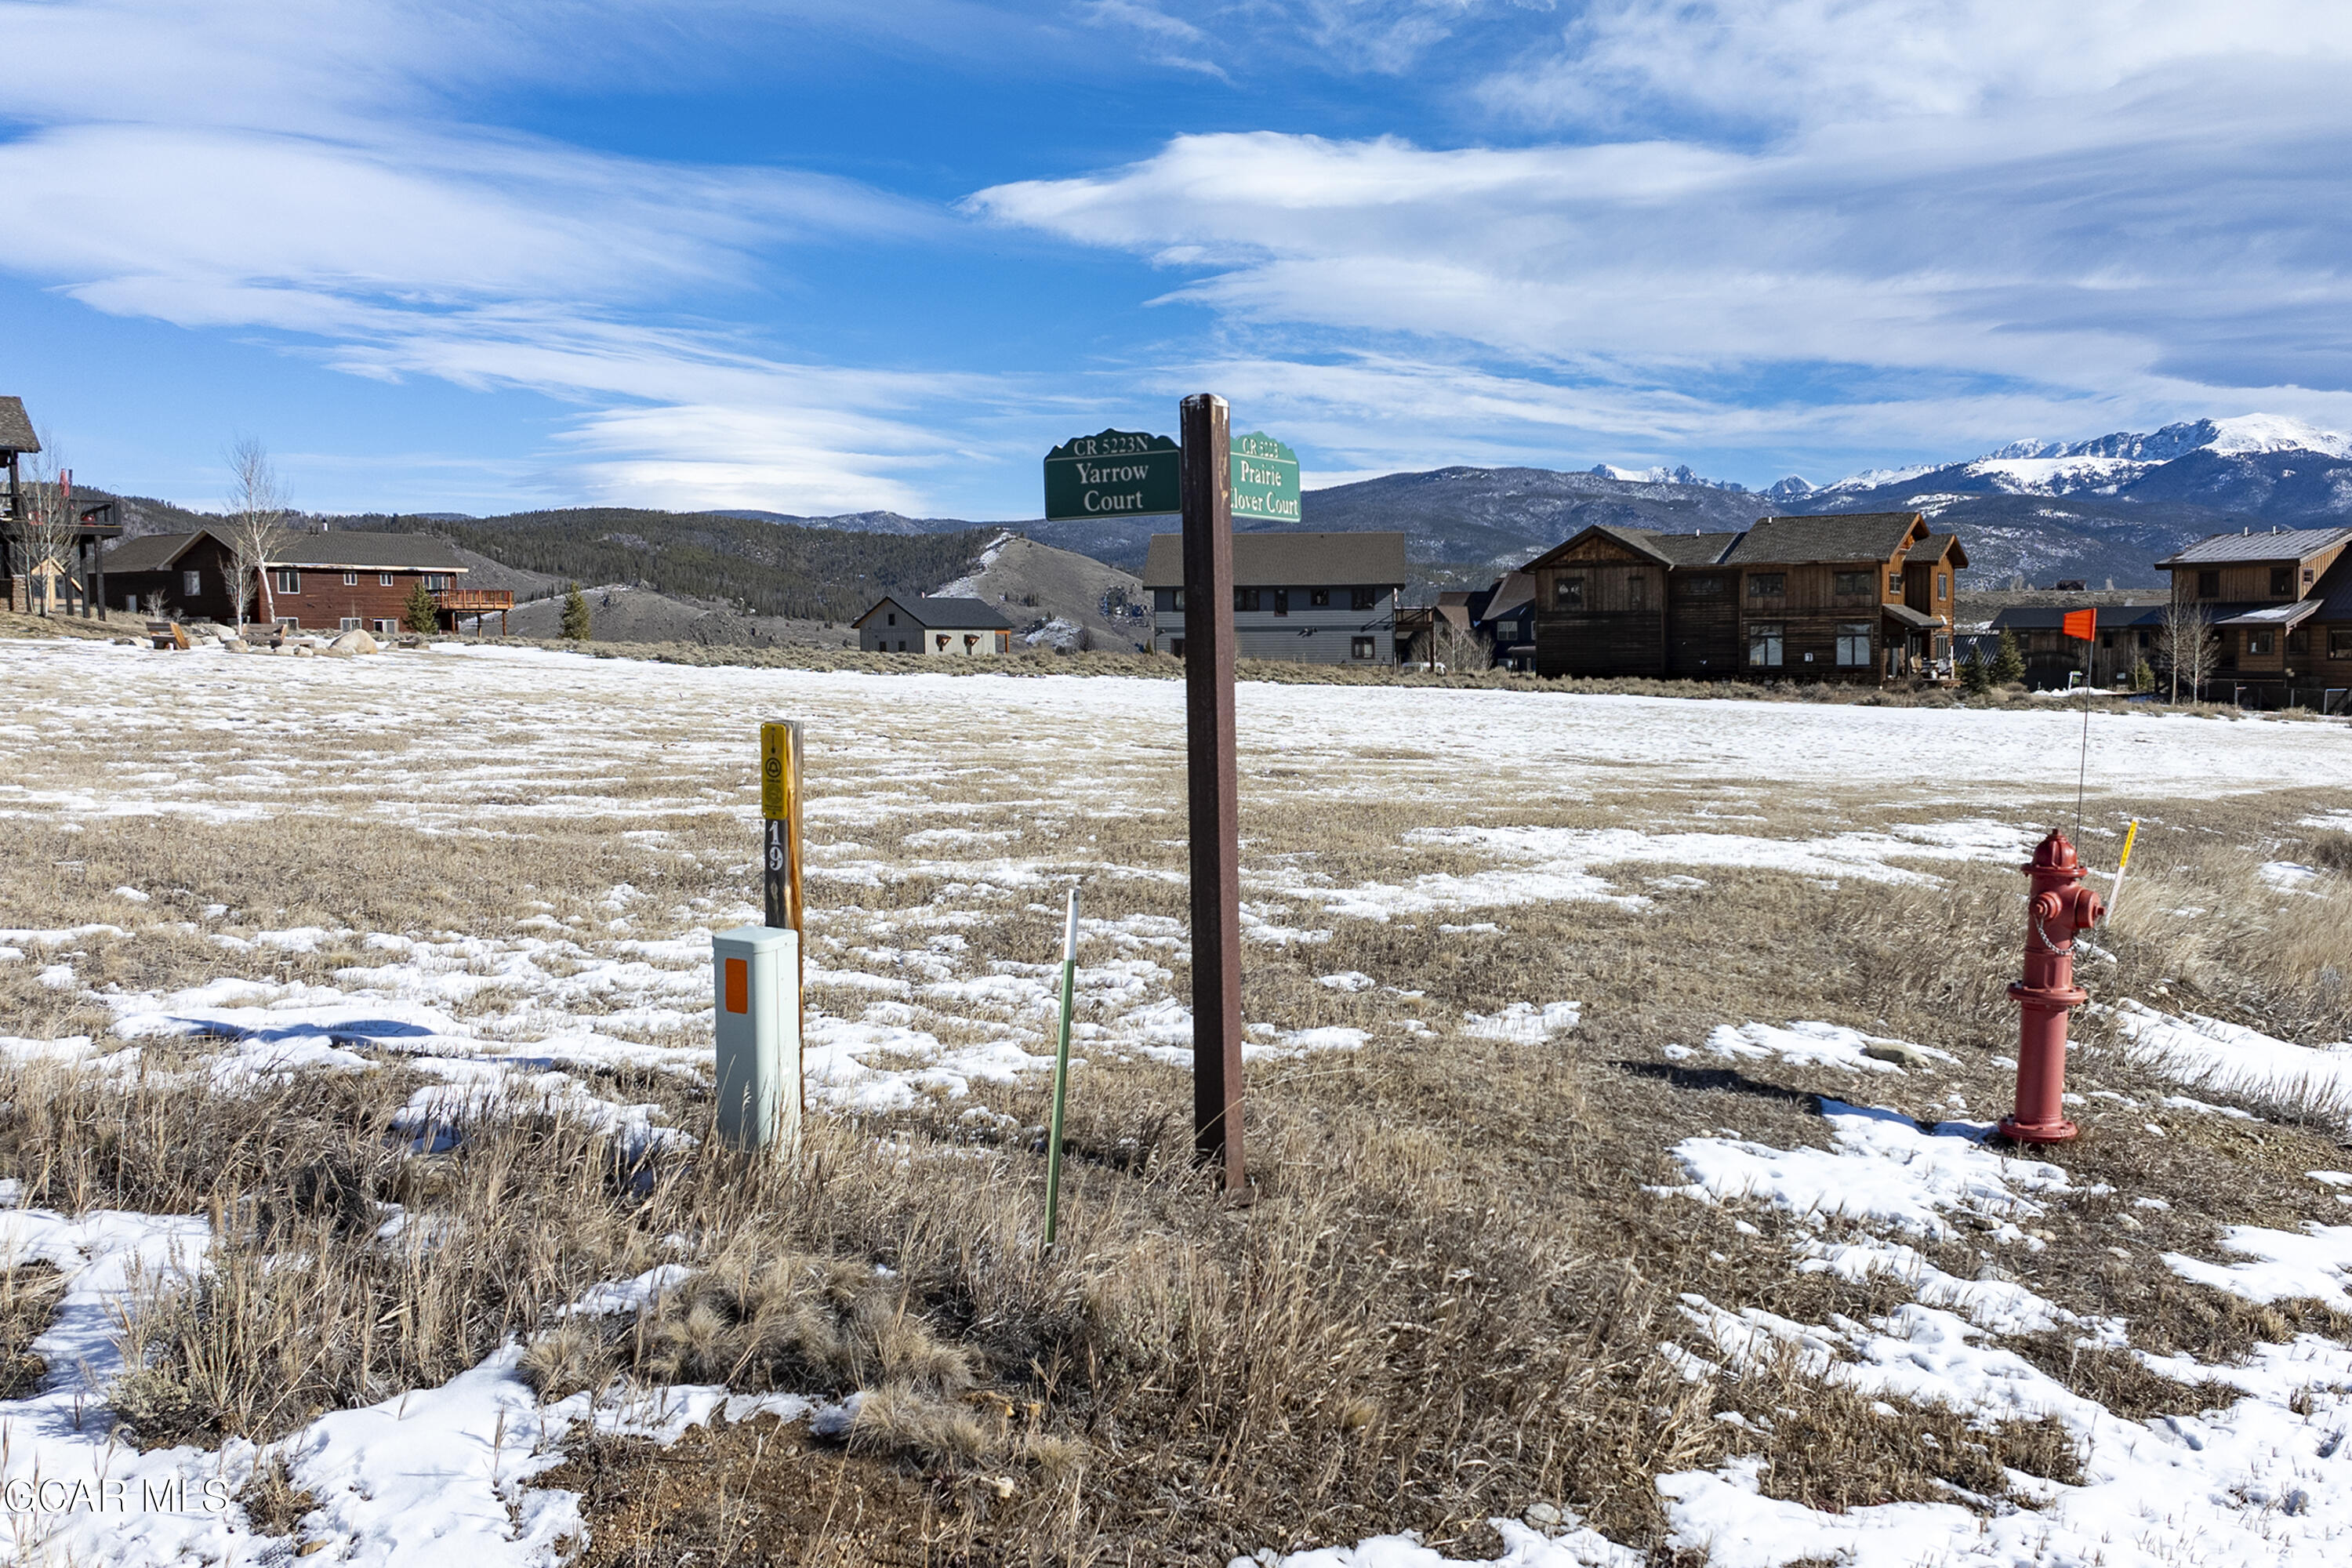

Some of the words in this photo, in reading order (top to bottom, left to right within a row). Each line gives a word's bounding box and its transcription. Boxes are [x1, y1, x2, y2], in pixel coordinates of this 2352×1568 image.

[1073, 439, 1098, 456] CR
[1102, 435, 1149, 455] 5223N
[1243, 437, 1257, 455] CR
[1260, 441, 1279, 459] 5223
[1076, 462, 1149, 485] Yarrow
[1240, 460, 1282, 486] Prairie
[1083, 490, 1143, 512] Court
[1266, 492, 1299, 515] Court
